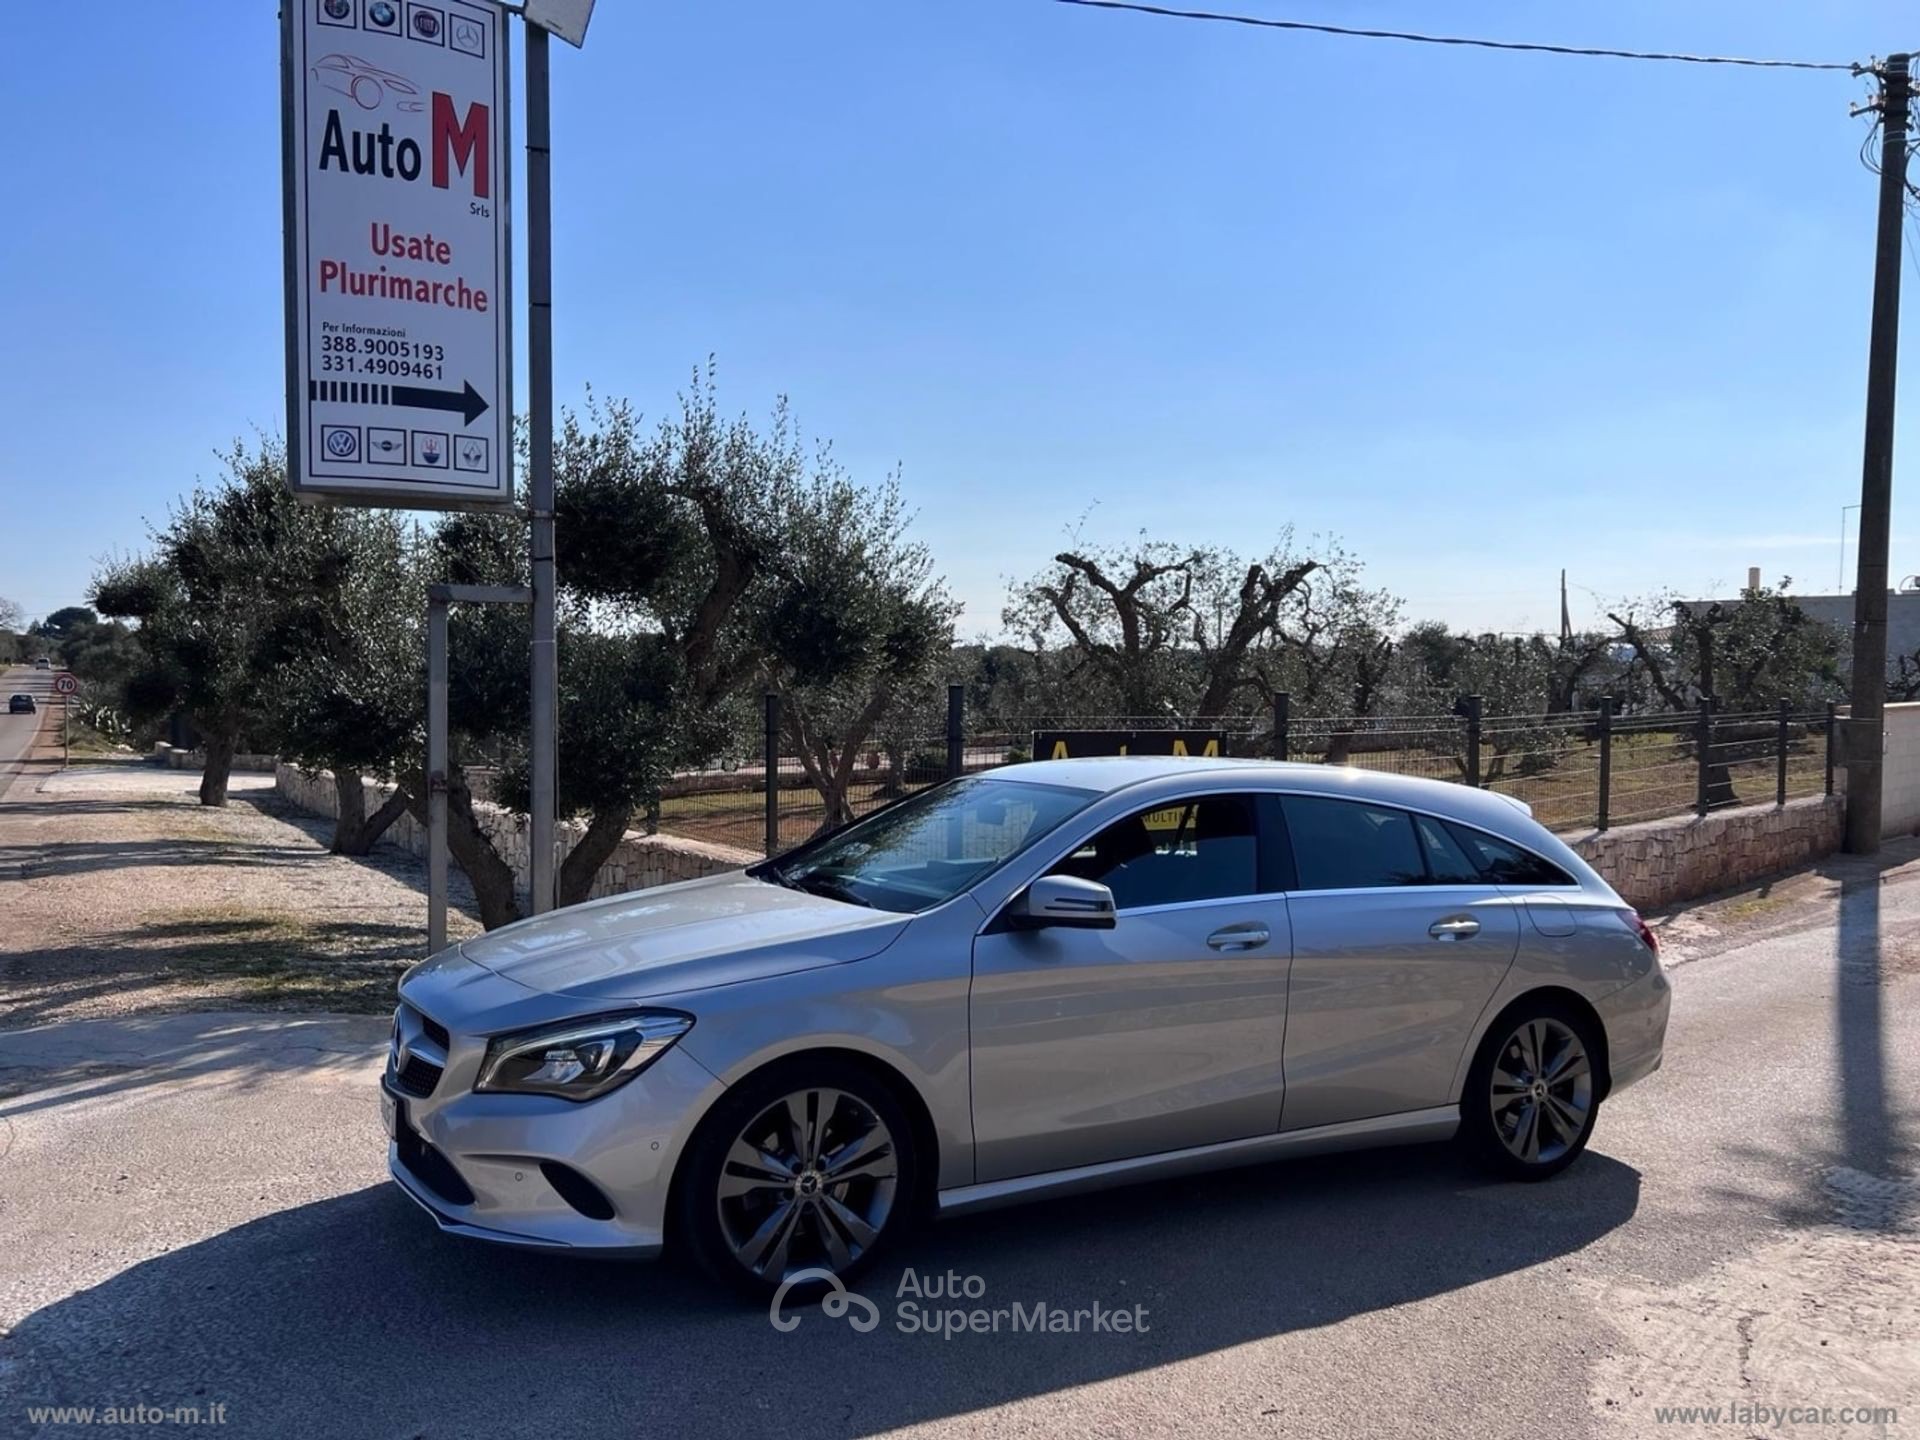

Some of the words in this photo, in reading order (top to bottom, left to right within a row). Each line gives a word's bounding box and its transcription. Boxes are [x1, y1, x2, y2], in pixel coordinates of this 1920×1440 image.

[319, 109, 421, 181] Auto
[432, 91, 489, 199] M
[469, 202, 490, 218] Srls
[371, 222, 451, 264] Usate
[320, 260, 488, 312] Plurimarche
[322, 321, 339, 332] Per
[342, 323, 406, 338] Informazioni
[321, 335, 444, 361] 388.9005193
[321, 355, 443, 380] 331.4909461
[61, 680, 72, 690] 70
